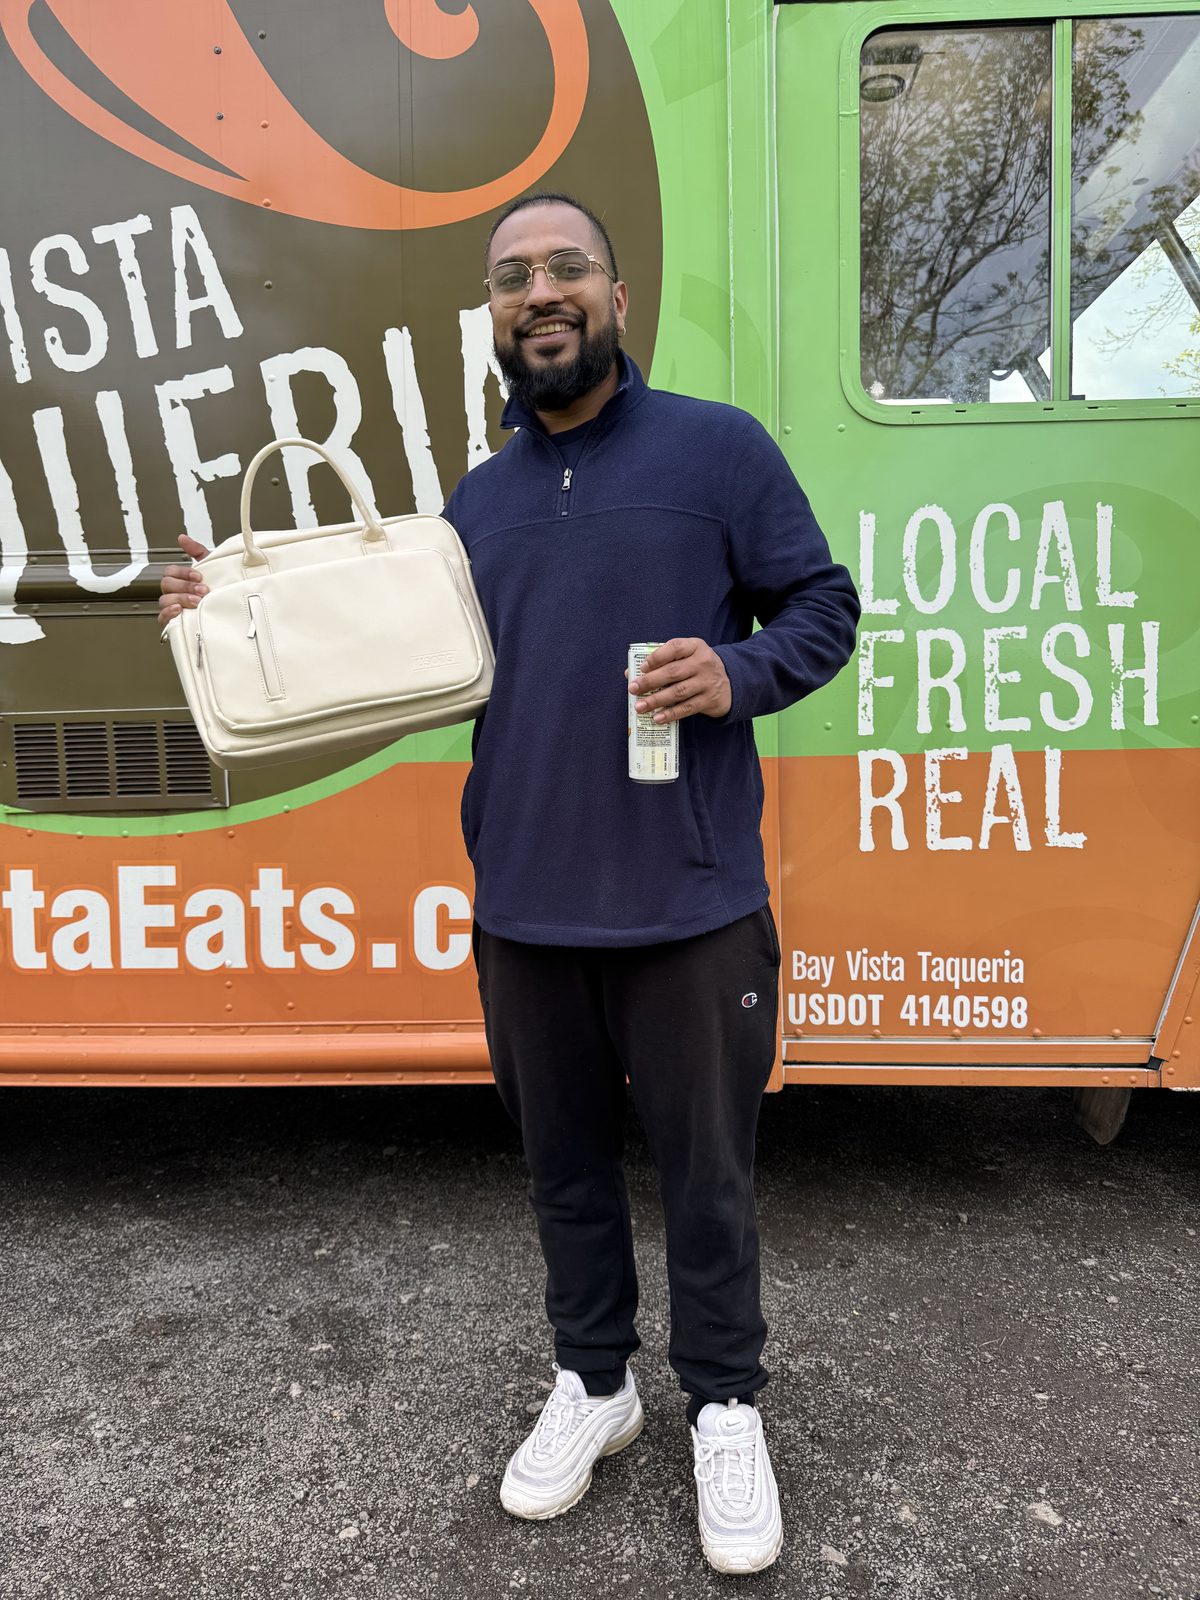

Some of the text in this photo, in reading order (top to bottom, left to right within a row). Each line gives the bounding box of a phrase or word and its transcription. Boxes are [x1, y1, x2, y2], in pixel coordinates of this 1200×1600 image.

[859, 500, 1138, 615] LOCAL
[858, 621, 1160, 735] FRESH
[858, 744, 1087, 851] REAL
[788, 993, 1028, 1029] USDOT 4140598
[792, 948, 1024, 989] Bay Vista Taqueria
